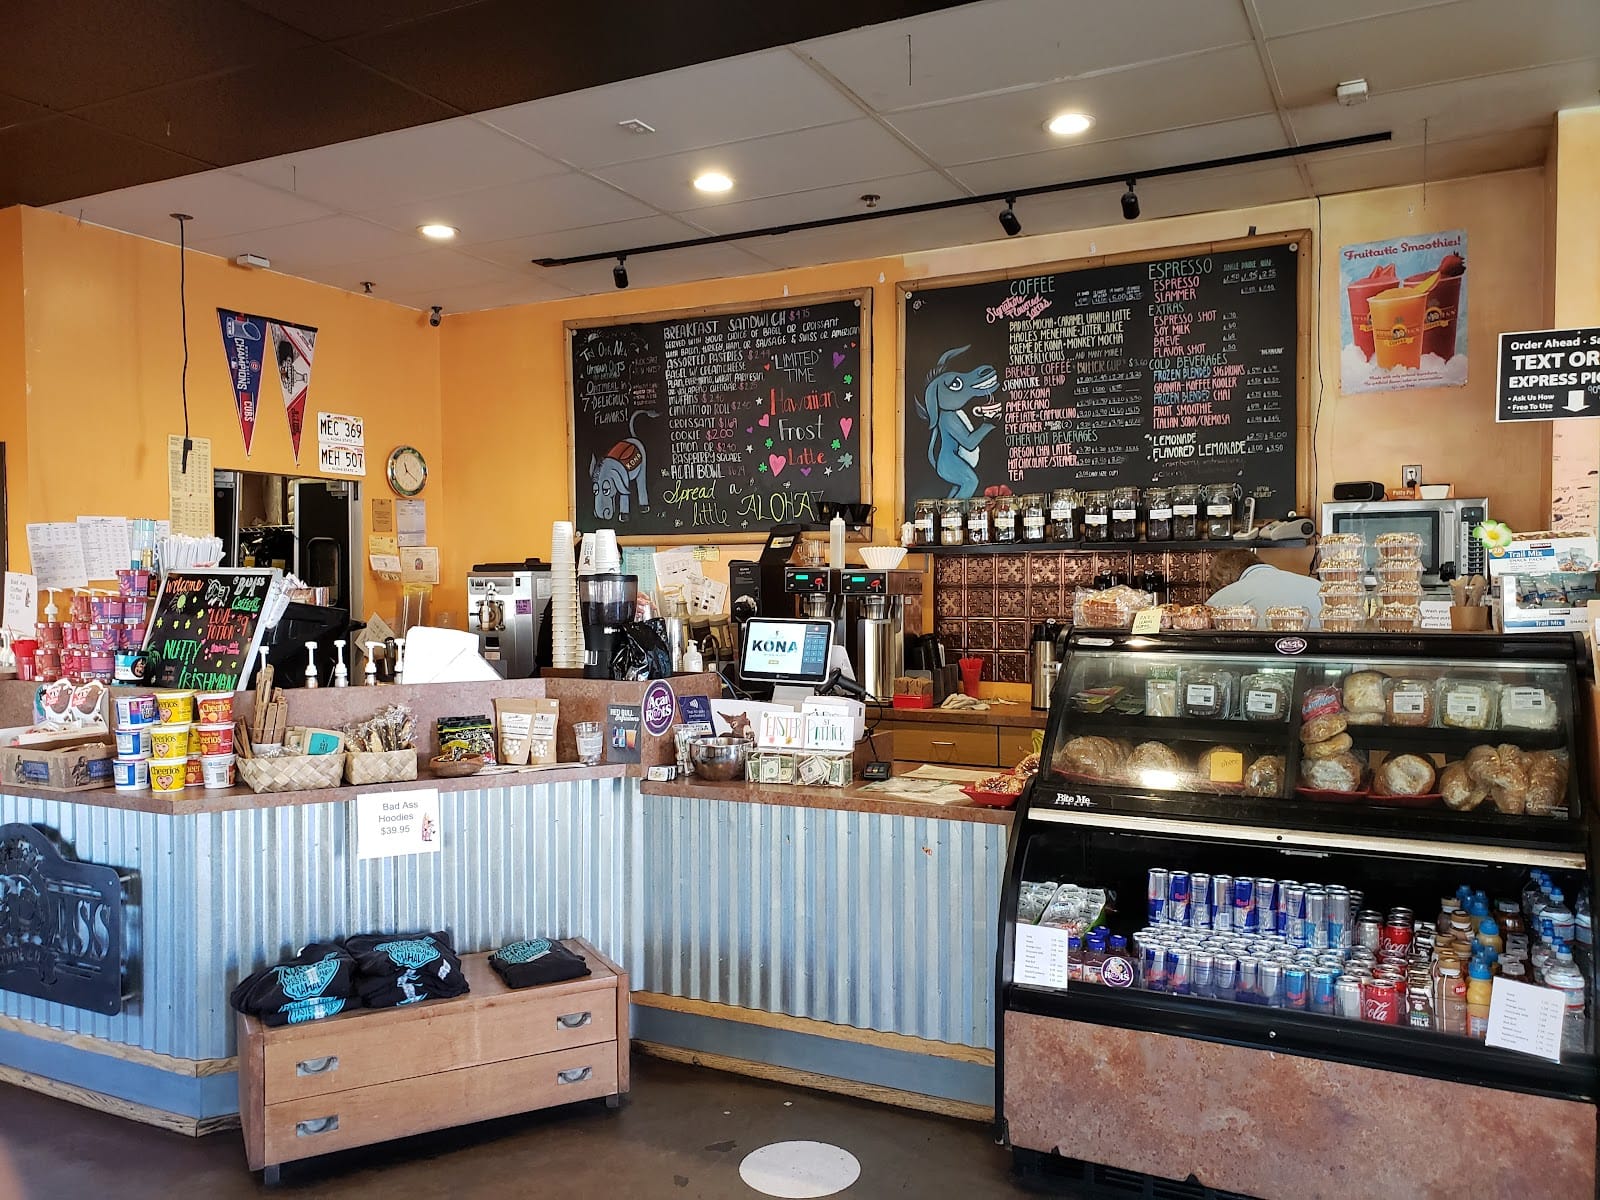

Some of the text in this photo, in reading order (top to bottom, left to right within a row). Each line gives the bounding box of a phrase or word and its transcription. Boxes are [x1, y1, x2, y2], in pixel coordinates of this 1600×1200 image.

[1344, 236, 1461, 260] Fruitastic Smoothies!
[1149, 258, 1212, 280] ESPRESSO
[1010, 276, 1054, 296] COFFEE
[1154, 276, 1200, 292] ESPRESSO
[1154, 288, 1196, 303] SLAMMER
[1058, 315, 1085, 326] CARAMEL
[1086, 312, 1110, 323] VANILLA
[1112, 308, 1131, 320] LATTE
[1149, 302, 1184, 316] EXTRAS
[664, 311, 786, 340] BREAKFAST SANDWICH
[1154, 310, 1216, 326] ESPRESSO SHOT
[665, 318, 840, 349] SERVED WITH YOUR CHOICE OF BAGEL OR CROISSANT
[1103, 322, 1124, 334] JUICE
[1154, 324, 1190, 336] SOY MILK
[743, 340, 751, 348] OR
[756, 336, 787, 348] SAUSAGE
[799, 332, 817, 342] SWISS
[832, 326, 860, 338] AMERICAN
[1010, 334, 1124, 354] KREME DE KONA MONKEY MOCHA
[1154, 335, 1180, 346] BREVE
[1511, 337, 1580, 350] Order Ahead
[1154, 343, 1206, 358] FLAVOR SHOT
[234, 338, 248, 390] CHAMPIONS
[666, 356, 706, 370] ASSORTED
[709, 352, 743, 364] PASTRIES
[1149, 353, 1228, 370] COLD BEVERAGES
[1512, 350, 1600, 370] TEXT OR
[665, 362, 746, 380] BAGEL CREAM CHEESE
[784, 367, 816, 383] TIME
[1006, 362, 1071, 378] BREWED COFFEE
[1154, 368, 1180, 382] FROZEN
[1182, 366, 1212, 379] BLENDED
[1002, 377, 1040, 392] SIGNATURE
[1044, 375, 1066, 386] BLEND
[1212, 377, 1237, 388] KOOLER
[1509, 373, 1578, 388] EXPRESS
[668, 394, 698, 405] MUFFINS
[770, 388, 839, 416] Hawaiian
[1010, 388, 1050, 400] 100% KONA
[1154, 392, 1179, 405] FROZEN
[1182, 390, 1210, 404] BLENDED
[1213, 389, 1230, 400] CHAI
[244, 401, 253, 422] CUBS
[582, 398, 590, 412] 7
[668, 402, 730, 417] CINNAMON ROLL
[1006, 399, 1050, 412] AMERICANO
[1154, 405, 1172, 418] FRUIT
[1176, 402, 1212, 415] SMOOTHIE
[320, 420, 362, 438] MEC 369
[669, 418, 716, 429] CROISSANT
[779, 414, 824, 441] Frost
[1005, 425, 1018, 434] EYE
[1020, 422, 1042, 433] OPENER
[1154, 417, 1178, 429] ITALIAN
[670, 428, 734, 441] COOKIE $2.00
[1006, 430, 1098, 446] OTHER HOT BEVERAGES
[1154, 432, 1196, 446] LEMONADE
[672, 442, 714, 452] LEMON OR
[1009, 446, 1034, 458] OREGON
[1036, 445, 1050, 456] CHAI
[1052, 444, 1072, 454] LATTE
[1153, 446, 1194, 458] FLAVORED
[1198, 440, 1246, 456] LEMONADE
[322, 448, 362, 468] MEH 507
[626, 453, 641, 470] KONA
[672, 452, 742, 464] RASPBERRY SQUARE
[788, 448, 826, 465] Latte
[696, 464, 724, 478] BOWL
[1008, 470, 1024, 480] TEA
[663, 480, 742, 508] Spread a
[693, 502, 730, 527] little
[209, 608, 232, 624] LOVE
[207, 625, 235, 640] POTION
[163, 640, 200, 664] NUTTY
[752, 640, 797, 652] KONA
[202, 704, 230, 712] Cheerios
[766, 717, 801, 738] EASTER
[151, 766, 180, 775] Cheerios
[382, 802, 400, 810] Bad
[1054, 793, 1091, 806] Bite Me
[378, 813, 414, 822] Hoodies
[380, 825, 410, 835] $39.95
[292, 977, 324, 994] MAHALO
[1410, 1017, 1429, 1027] MILK
